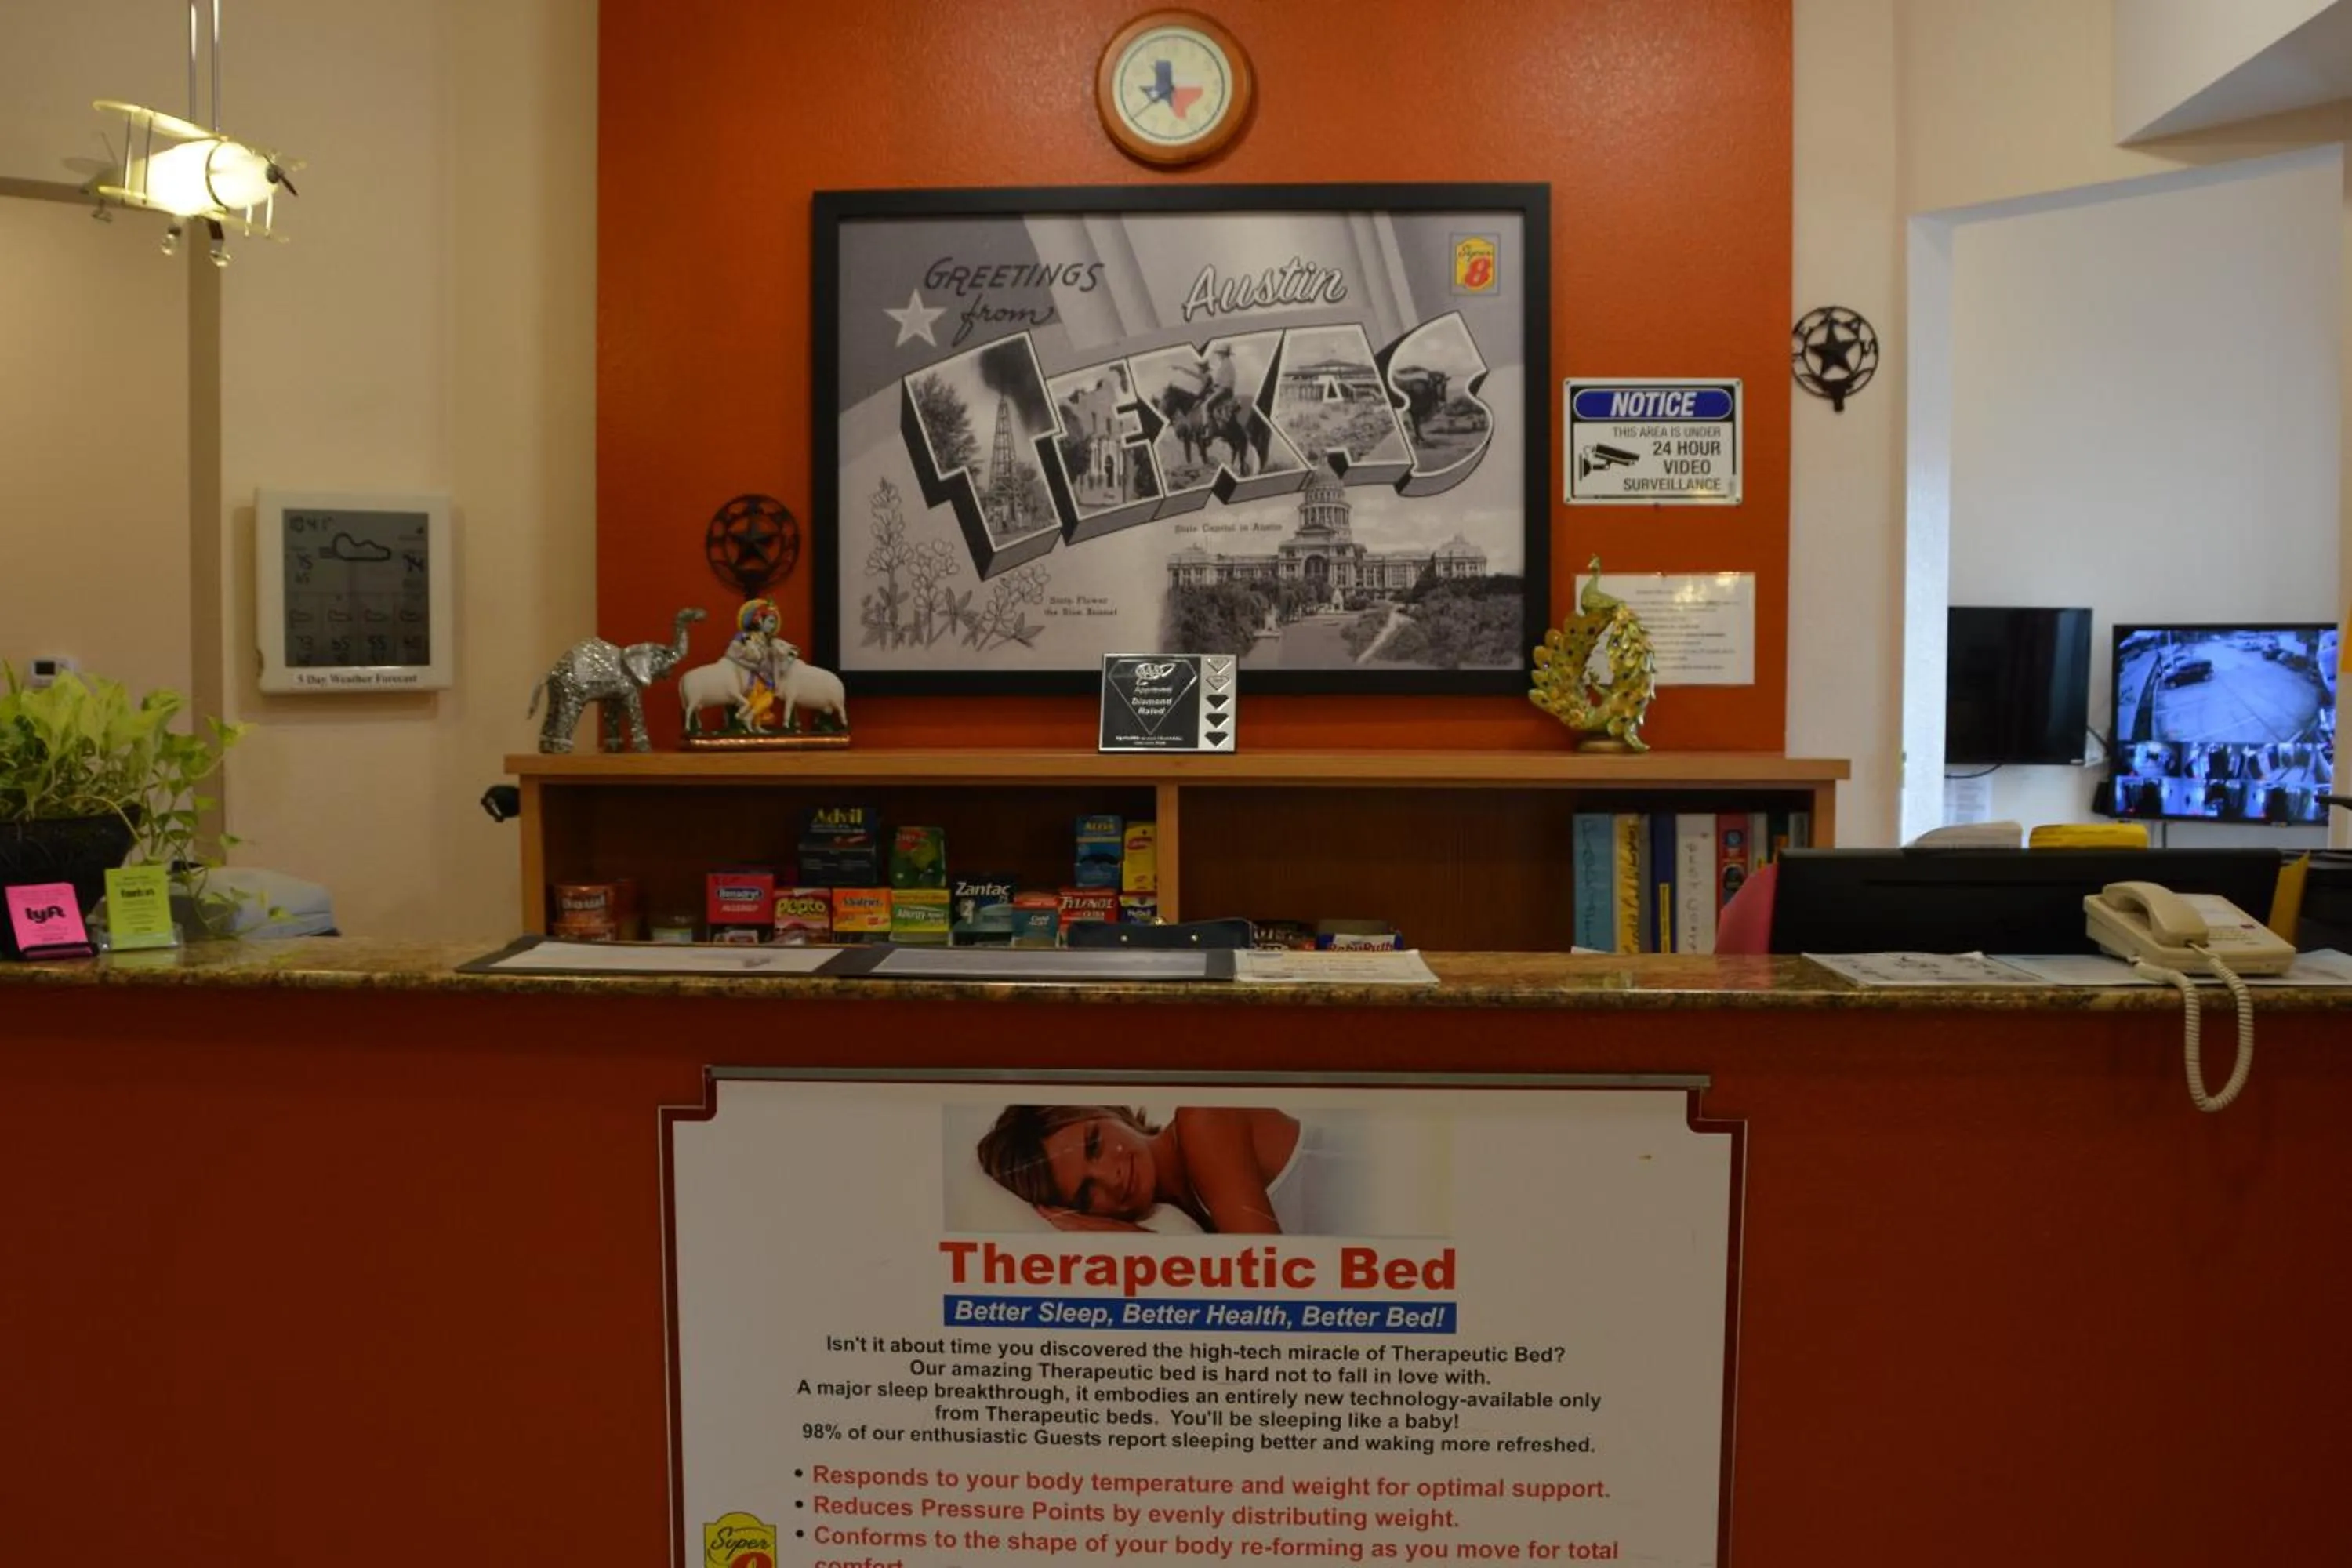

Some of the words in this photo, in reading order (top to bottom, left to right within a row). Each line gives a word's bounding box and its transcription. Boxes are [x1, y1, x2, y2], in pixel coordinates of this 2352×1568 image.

[924, 256, 1105, 295] GREETINGS
[1464, 256, 1491, 288] 8
[1182, 256, 1348, 323] Austin
[953, 294, 1058, 346] from
[1609, 390, 1698, 417] NOTICE
[901, 310, 1496, 582] TEXAS
[1613, 426, 1637, 438] THIS
[1639, 426, 1668, 438] AREA
[1671, 426, 1682, 438] IS
[1684, 426, 1721, 438] UNDER
[1653, 441, 1671, 456] 24
[1677, 441, 1721, 456] HOUR
[1663, 459, 1711, 475] VIDEO
[1623, 478, 1721, 492] SURVEILLANCE
[306, 674, 326, 686] Day
[329, 673, 373, 684] Weather
[376, 673, 419, 684] Forecast
[1131, 697, 1172, 706] Diamond
[812, 806, 865, 825] Advil
[955, 880, 1011, 897] Zantac
[938, 1241, 1316, 1298] Therapeutic
[1340, 1247, 1456, 1291] Bed
[954, 1300, 1033, 1323] Better
[1038, 1301, 1113, 1330] Sleep,
[1122, 1302, 1200, 1325] Better
[1206, 1304, 1293, 1330] Health,
[1301, 1305, 1381, 1327] Better
[1385, 1306, 1446, 1328] Bed!
[827, 1335, 866, 1352] Isn't
[873, 1335, 885, 1353] it
[890, 1336, 945, 1355] about
[950, 1338, 992, 1356] time
[997, 1343, 1033, 1360] you
[1040, 1339, 1147, 1359] discovered
[1152, 1341, 1183, 1359] the
[1189, 1341, 1282, 1363] high-tech
[1288, 1344, 1360, 1362] miracle
[1366, 1344, 1387, 1362] of
[1391, 1344, 1508, 1366] Therapeutic
[1515, 1345, 1566, 1363] Bed?
[909, 1359, 946, 1377] Our
[951, 1361, 1032, 1383] amazing
[1037, 1361, 1154, 1384] Therapeutic
[1160, 1363, 1196, 1381] bed
[1202, 1364, 1218, 1382] is
[1225, 1364, 1269, 1384] hard
[1276, 1367, 1307, 1383] not
[1312, 1367, 1332, 1383] to
[1338, 1367, 1367, 1384] fall
[1374, 1367, 1392, 1385] in
[1398, 1367, 1439, 1385] love
[1444, 1367, 1491, 1385] with.
[797, 1379, 811, 1396] A
[817, 1380, 872, 1400] major
[877, 1380, 929, 1403] sleep
[934, 1381, 1070, 1405] breakthrough,
[1076, 1385, 1089, 1402] it
[1094, 1385, 1189, 1404] embodies
[1195, 1391, 1219, 1404] an
[1225, 1388, 1298, 1410] entirely
[1304, 1392, 1345, 1406] new
[1349, 1389, 1553, 1412] technology-available
[1559, 1391, 1602, 1413] only
[935, 1404, 979, 1421] from
[985, 1405, 1100, 1428] Therapeutic
[1106, 1407, 1159, 1426] beds.
[1170, 1408, 1223, 1427] You'll
[1229, 1410, 1253, 1427] be
[1258, 1410, 1341, 1432] sleeping
[1348, 1411, 1382, 1429] like
[1388, 1416, 1399, 1429] a
[1406, 1412, 1459, 1434] baby!
[802, 1422, 842, 1440] 98%
[848, 1424, 867, 1441] of
[873, 1428, 906, 1442] our
[910, 1426, 1028, 1445] enthusiastic
[1033, 1428, 1102, 1447] Guests
[1108, 1432, 1167, 1451] report
[1171, 1432, 1254, 1454] sleeping
[1260, 1432, 1318, 1450] better
[1323, 1433, 1359, 1451] and
[1365, 1434, 1435, 1457] waking
[1440, 1439, 1491, 1453] more
[1497, 1436, 1595, 1454] refreshed.
[813, 1464, 929, 1490] Responds
[936, 1468, 960, 1488] to
[966, 1473, 1020, 1494] your
[1026, 1470, 1084, 1496] body
[1091, 1473, 1234, 1497] temperature
[1241, 1475, 1284, 1495] and
[1291, 1475, 1370, 1501] weight
[1376, 1475, 1410, 1497] for
[1417, 1477, 1504, 1502] optimal
[1512, 1479, 1610, 1503] support.
[814, 1494, 913, 1517] Reduces
[921, 1497, 1025, 1520] Pressure
[1033, 1501, 1105, 1523] Points
[1113, 1502, 1141, 1528] by
[1148, 1504, 1225, 1530] evenly
[1232, 1504, 1367, 1532] distributing
[1374, 1507, 1459, 1533] weight.
[710, 1526, 771, 1559] Super
[814, 1525, 927, 1548] Conforms
[934, 1530, 957, 1549] to
[964, 1530, 1000, 1550] the
[1007, 1531, 1078, 1556] shape
[1085, 1533, 1109, 1553] of
[1115, 1538, 1168, 1559] your
[1175, 1534, 1233, 1561] body
[1241, 1537, 1363, 1563] re-forming
[1370, 1543, 1398, 1559] as
[1405, 1543, 1449, 1563] you
[1457, 1543, 1521, 1559] move
[1527, 1539, 1561, 1560] for
[1567, 1540, 1618, 1561] total
